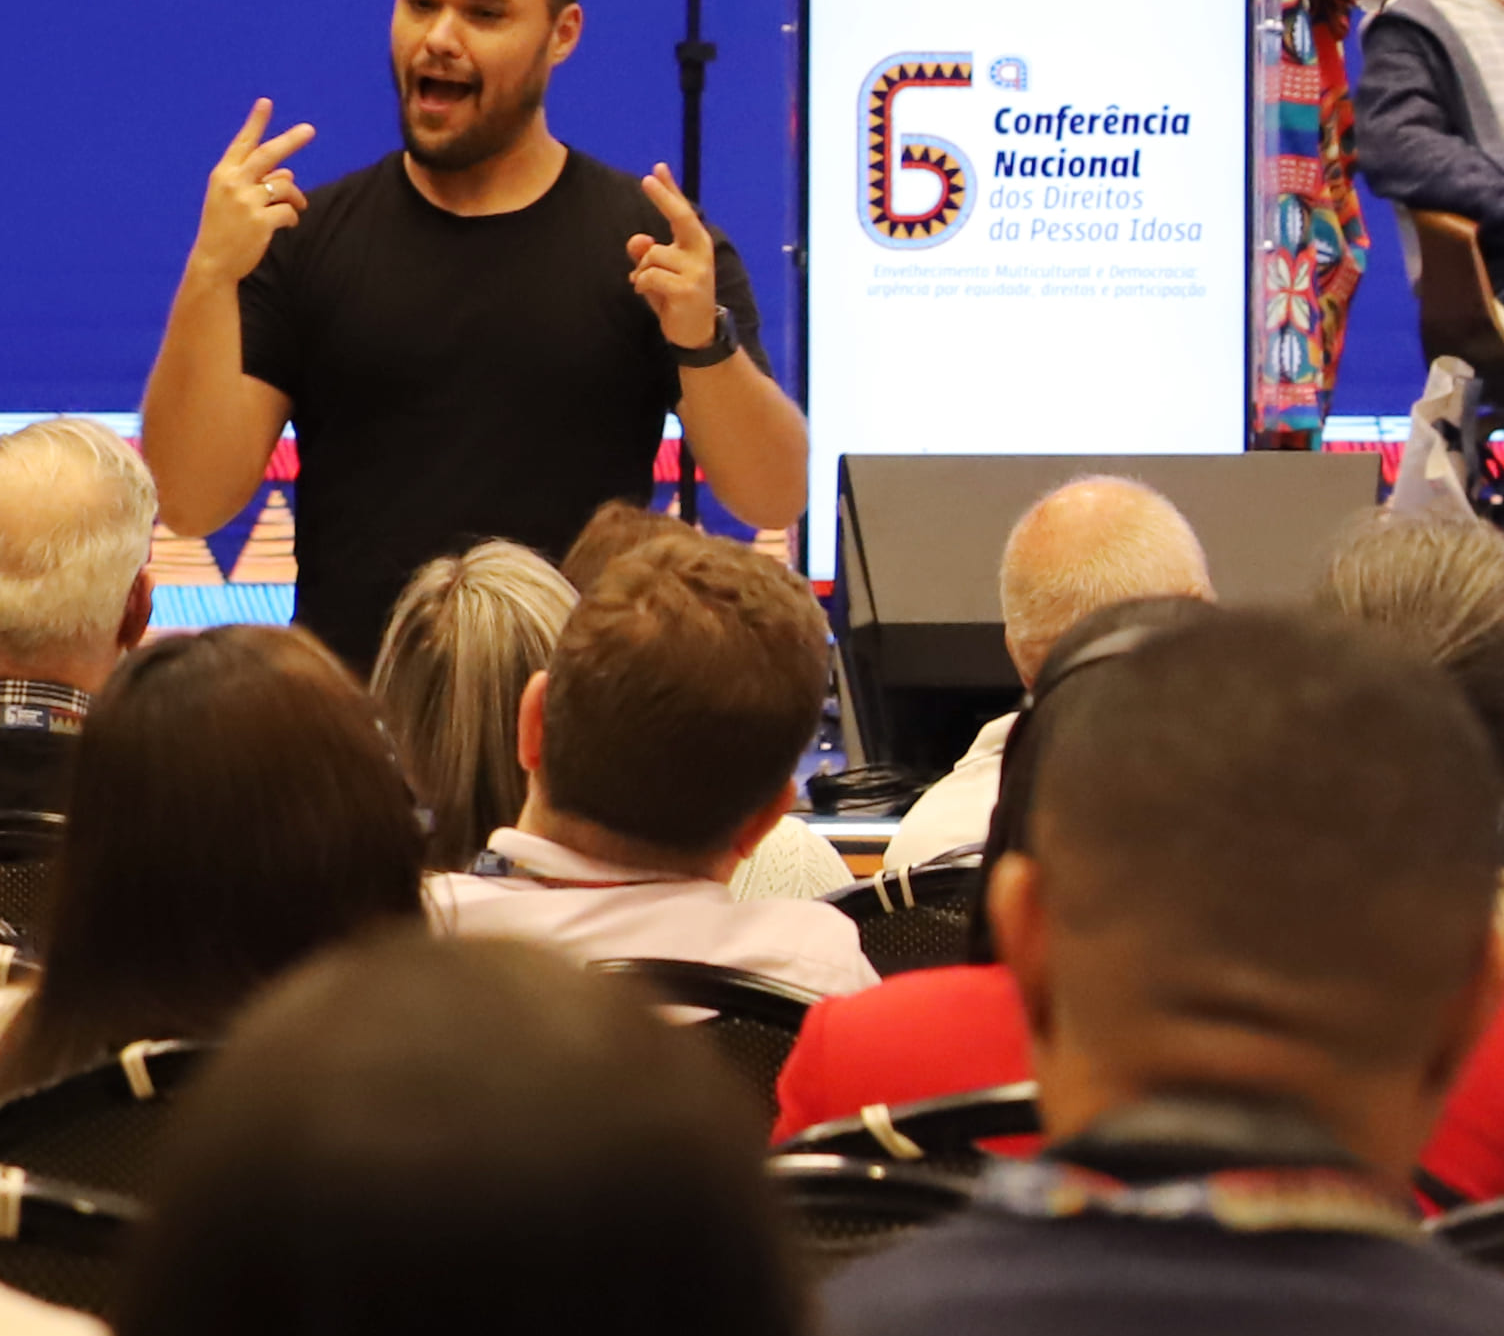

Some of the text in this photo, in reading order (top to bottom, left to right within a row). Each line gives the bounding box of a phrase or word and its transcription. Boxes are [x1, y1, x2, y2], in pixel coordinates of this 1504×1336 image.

[993, 103, 1193, 142] Conferência
[993, 147, 1143, 179] Nacional
[989, 184, 1145, 210] dos Direitos
[989, 217, 1203, 242] da Pessoa Idosa
[873, 263, 990, 280] Envelhecimento
[994, 263, 1092, 280] Multicultural
[866, 281, 931, 299] urgência
[1113, 282, 1208, 300] participação
